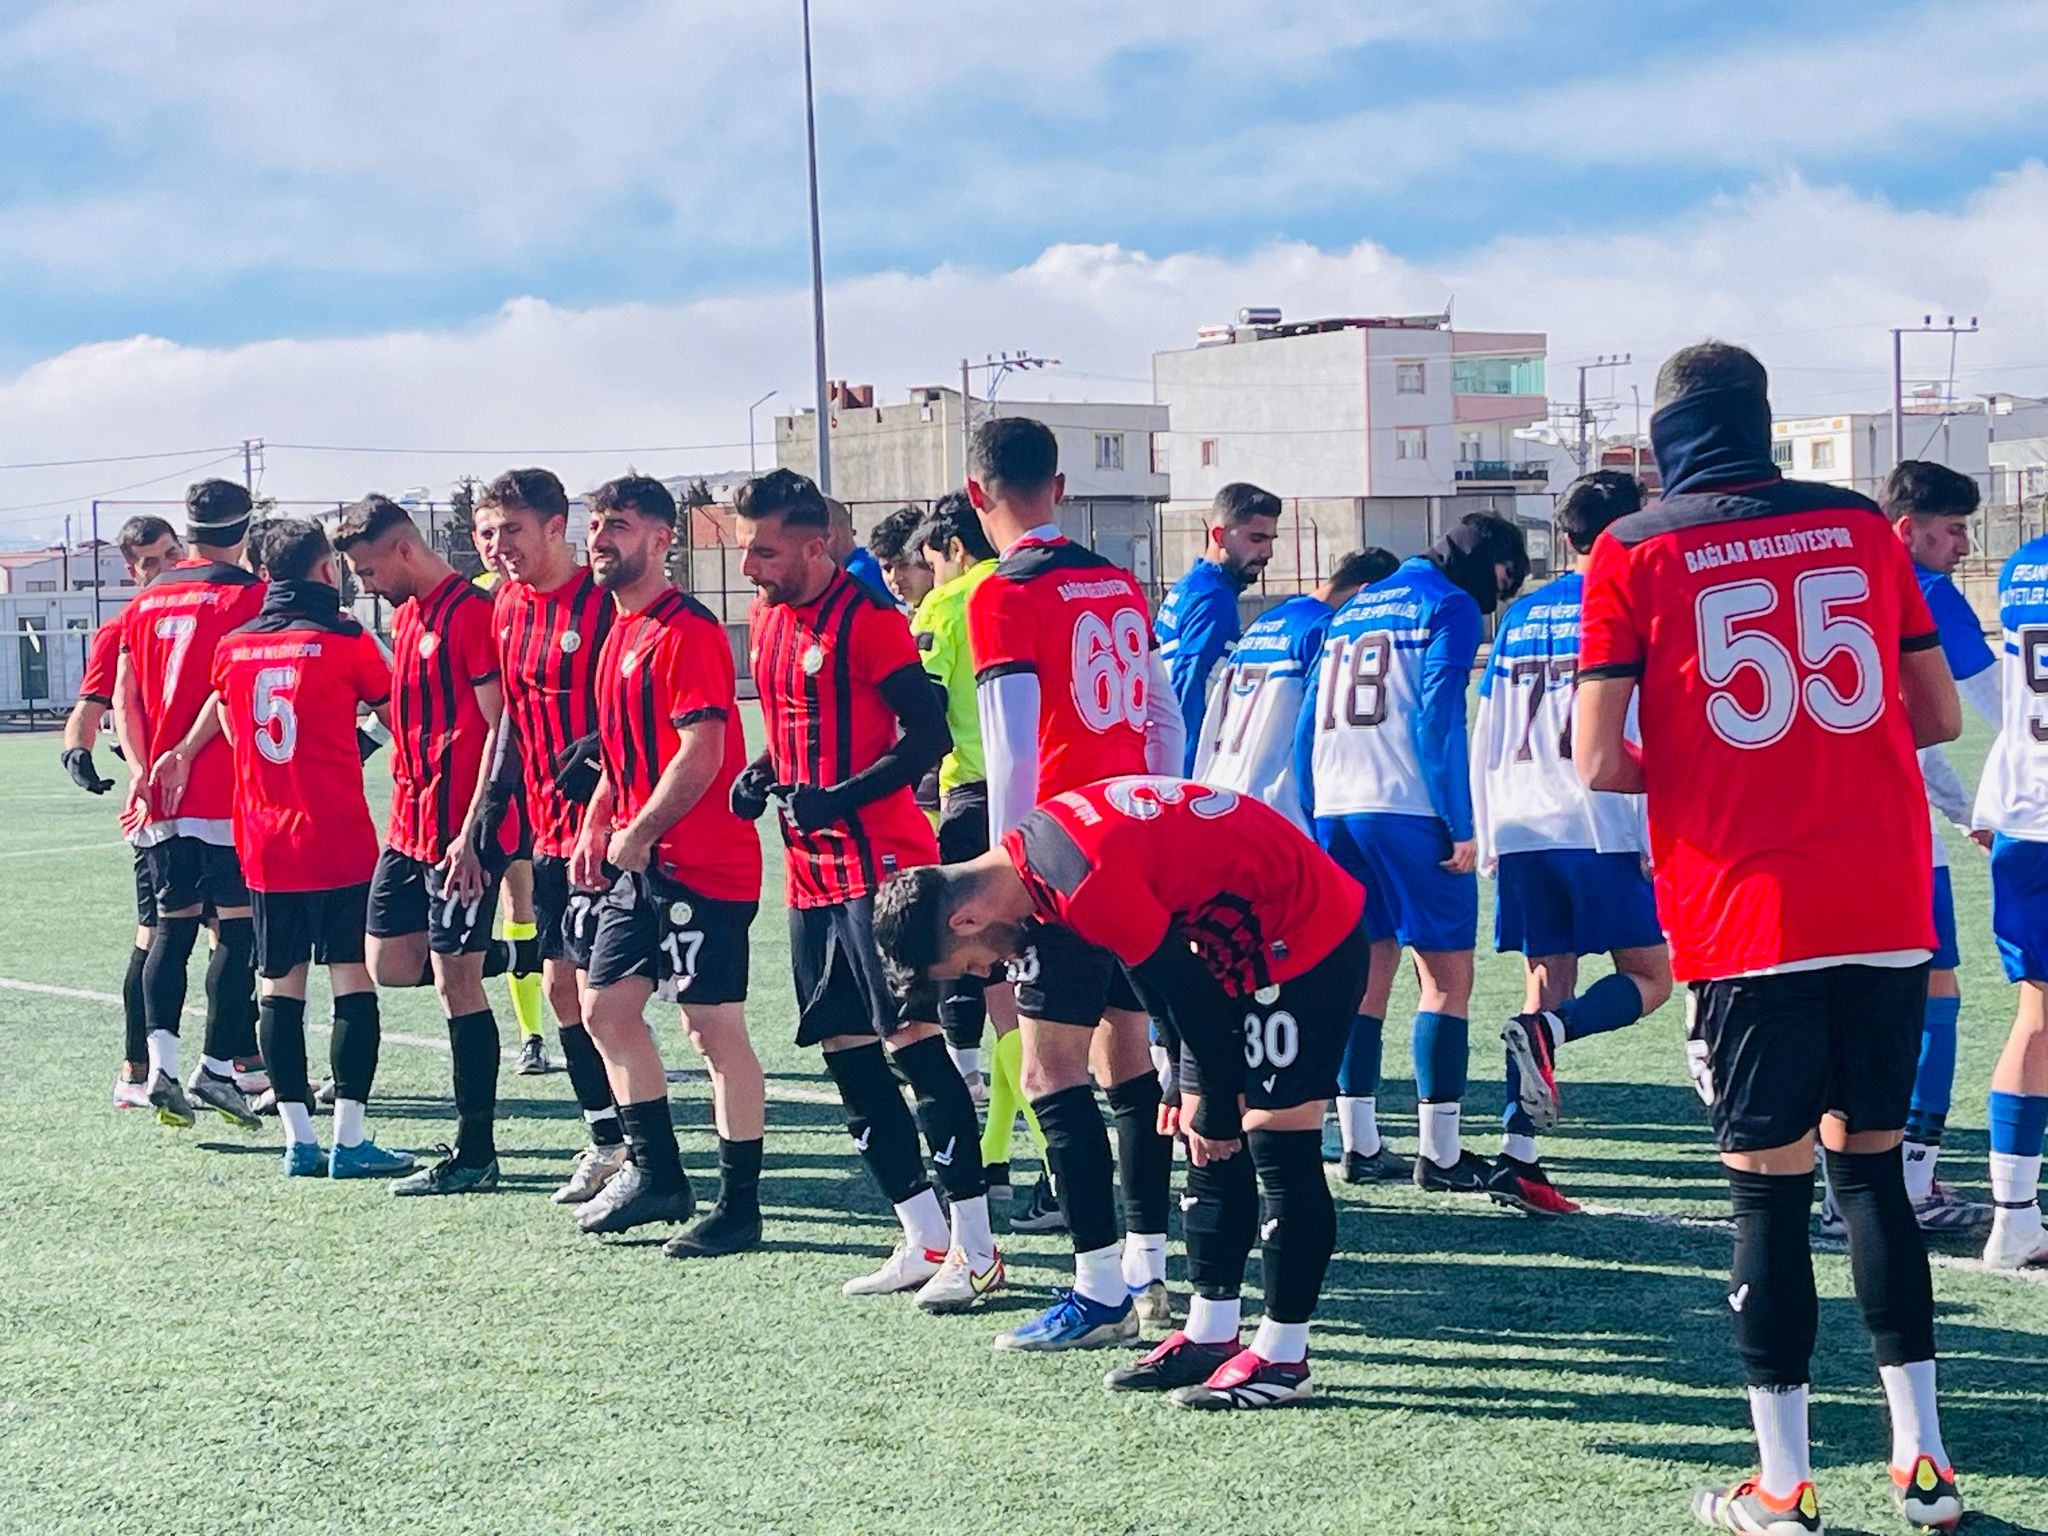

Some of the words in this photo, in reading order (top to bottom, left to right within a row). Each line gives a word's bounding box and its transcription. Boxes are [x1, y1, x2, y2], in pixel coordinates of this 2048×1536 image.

[1684, 541, 1748, 573] BAĞLAR
[1748, 527, 1853, 560] BELEDİYESPOR
[155, 614, 197, 710] 7
[1070, 607, 1150, 735] 68
[1323, 631, 1392, 732] 18
[1694, 565, 1886, 750] 55
[252, 667, 300, 765] 5
[660, 929, 704, 976] 17
[1243, 1010, 1299, 1069] 30
